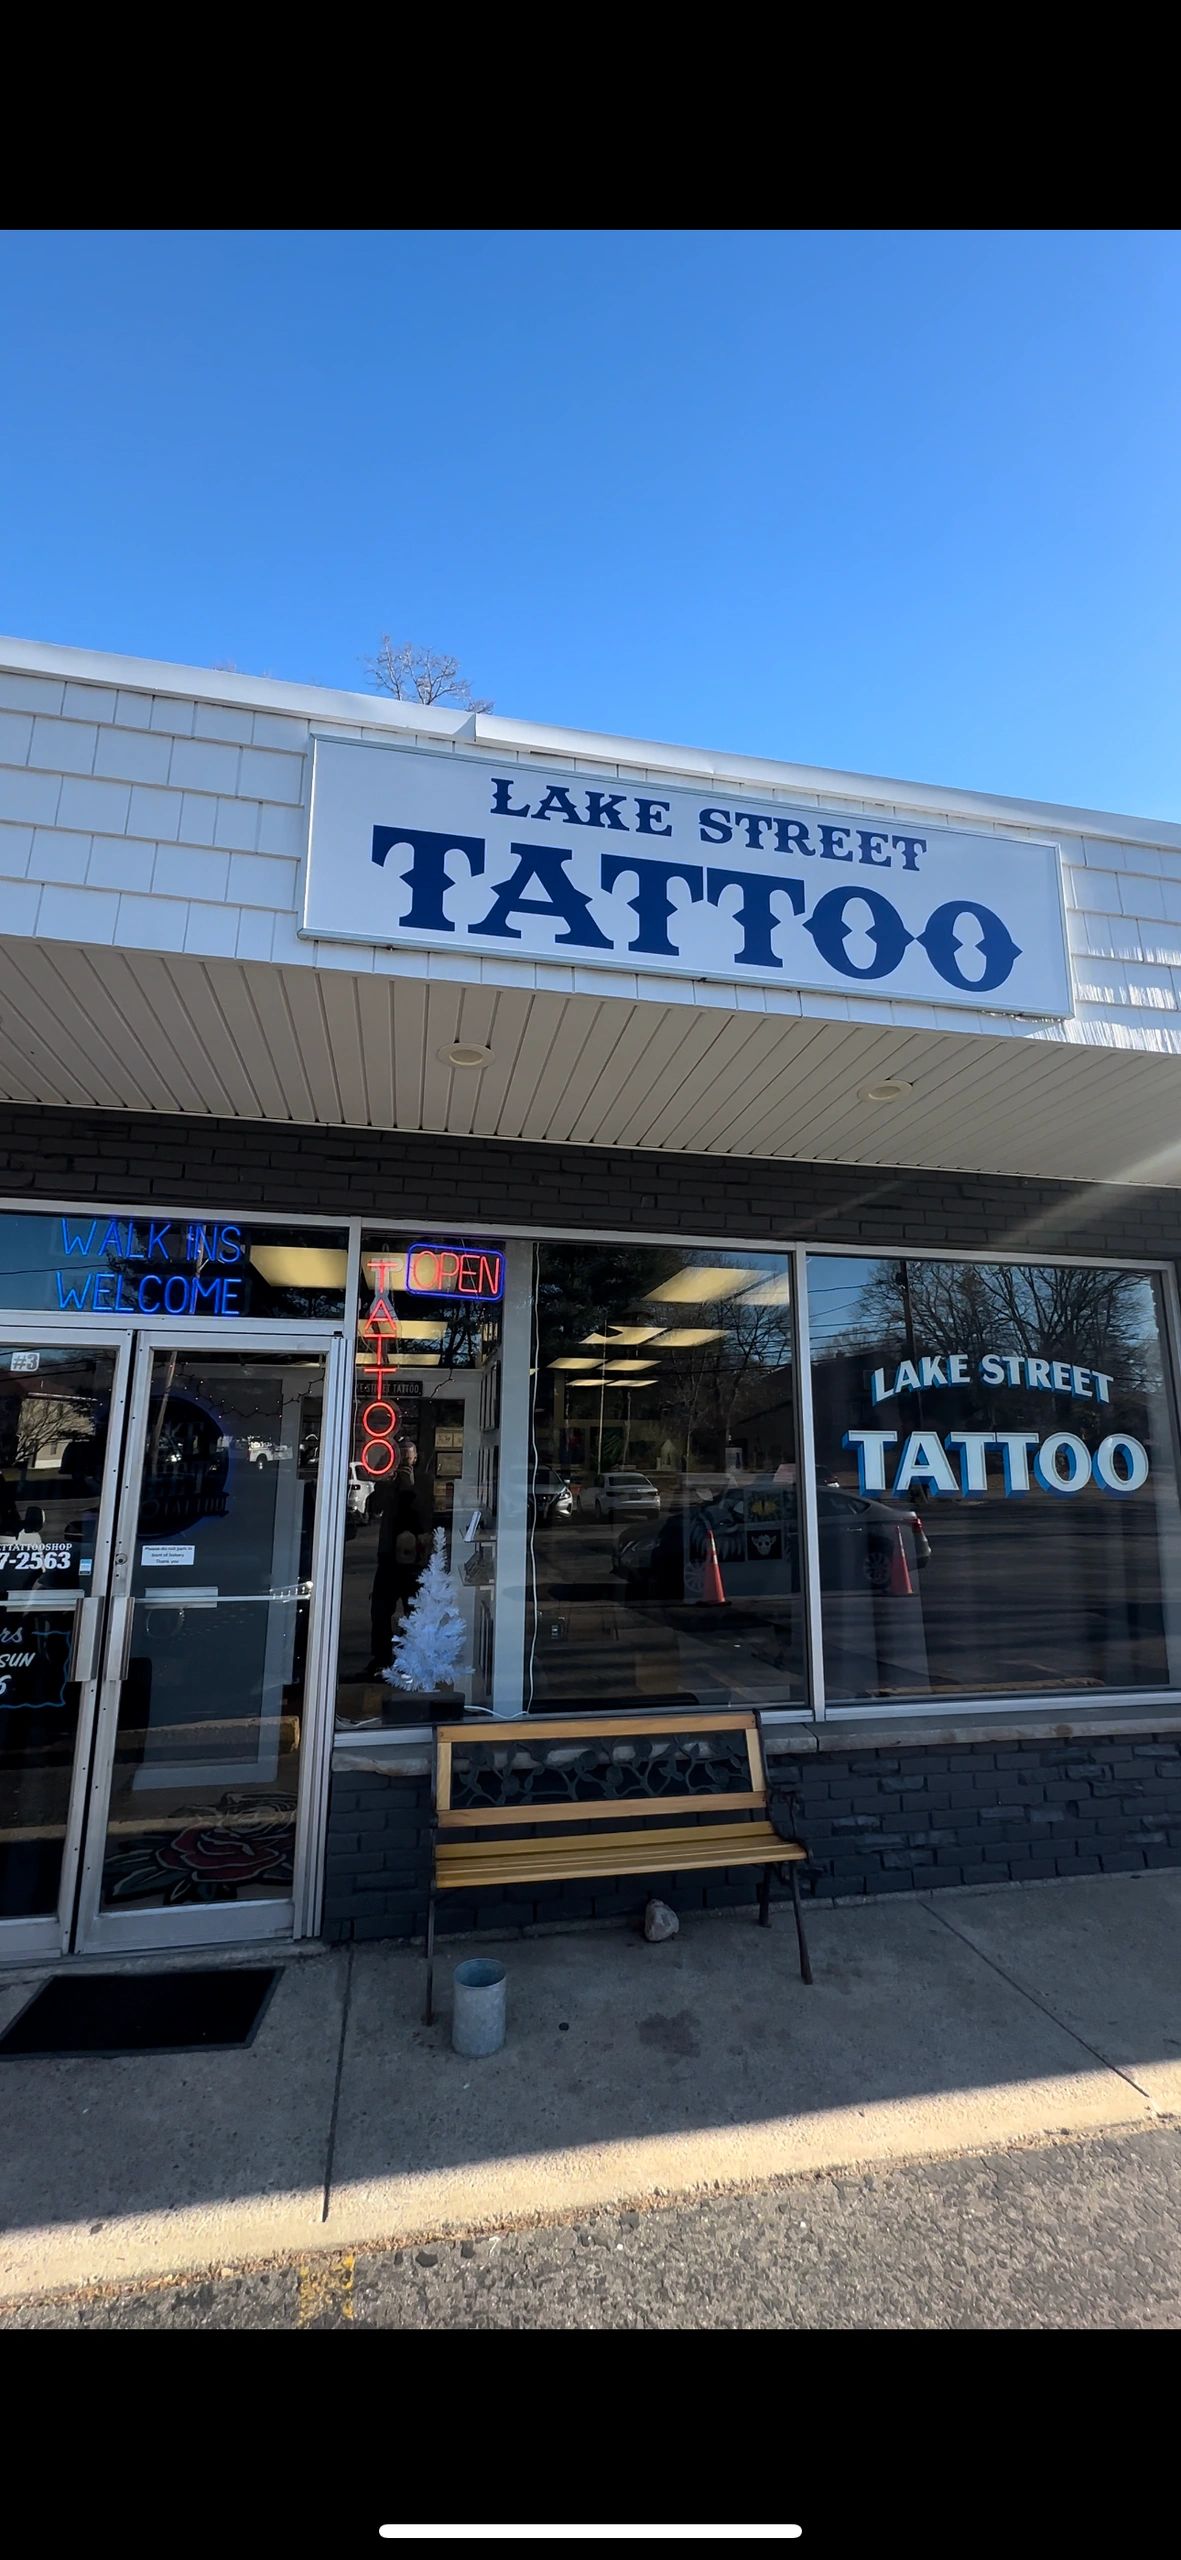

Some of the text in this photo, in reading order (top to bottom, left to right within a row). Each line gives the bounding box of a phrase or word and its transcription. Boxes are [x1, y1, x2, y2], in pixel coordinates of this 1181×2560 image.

[490, 777, 928, 872] LAKE STREET
[371, 824, 1023, 992] TATTOO
[61, 1216, 242, 1263] WALK INS
[56, 1270, 243, 1315] WELCOME
[412, 1250, 501, 1295] OPEN
[13, 1353, 38, 1370] #3
[361, 1259, 399, 1476] TATTOO
[872, 1353, 1114, 1407] LAKE STREET
[842, 1430, 1149, 1498] TATTOO
[0, 1543, 72, 1551] TTATTOOSHOP
